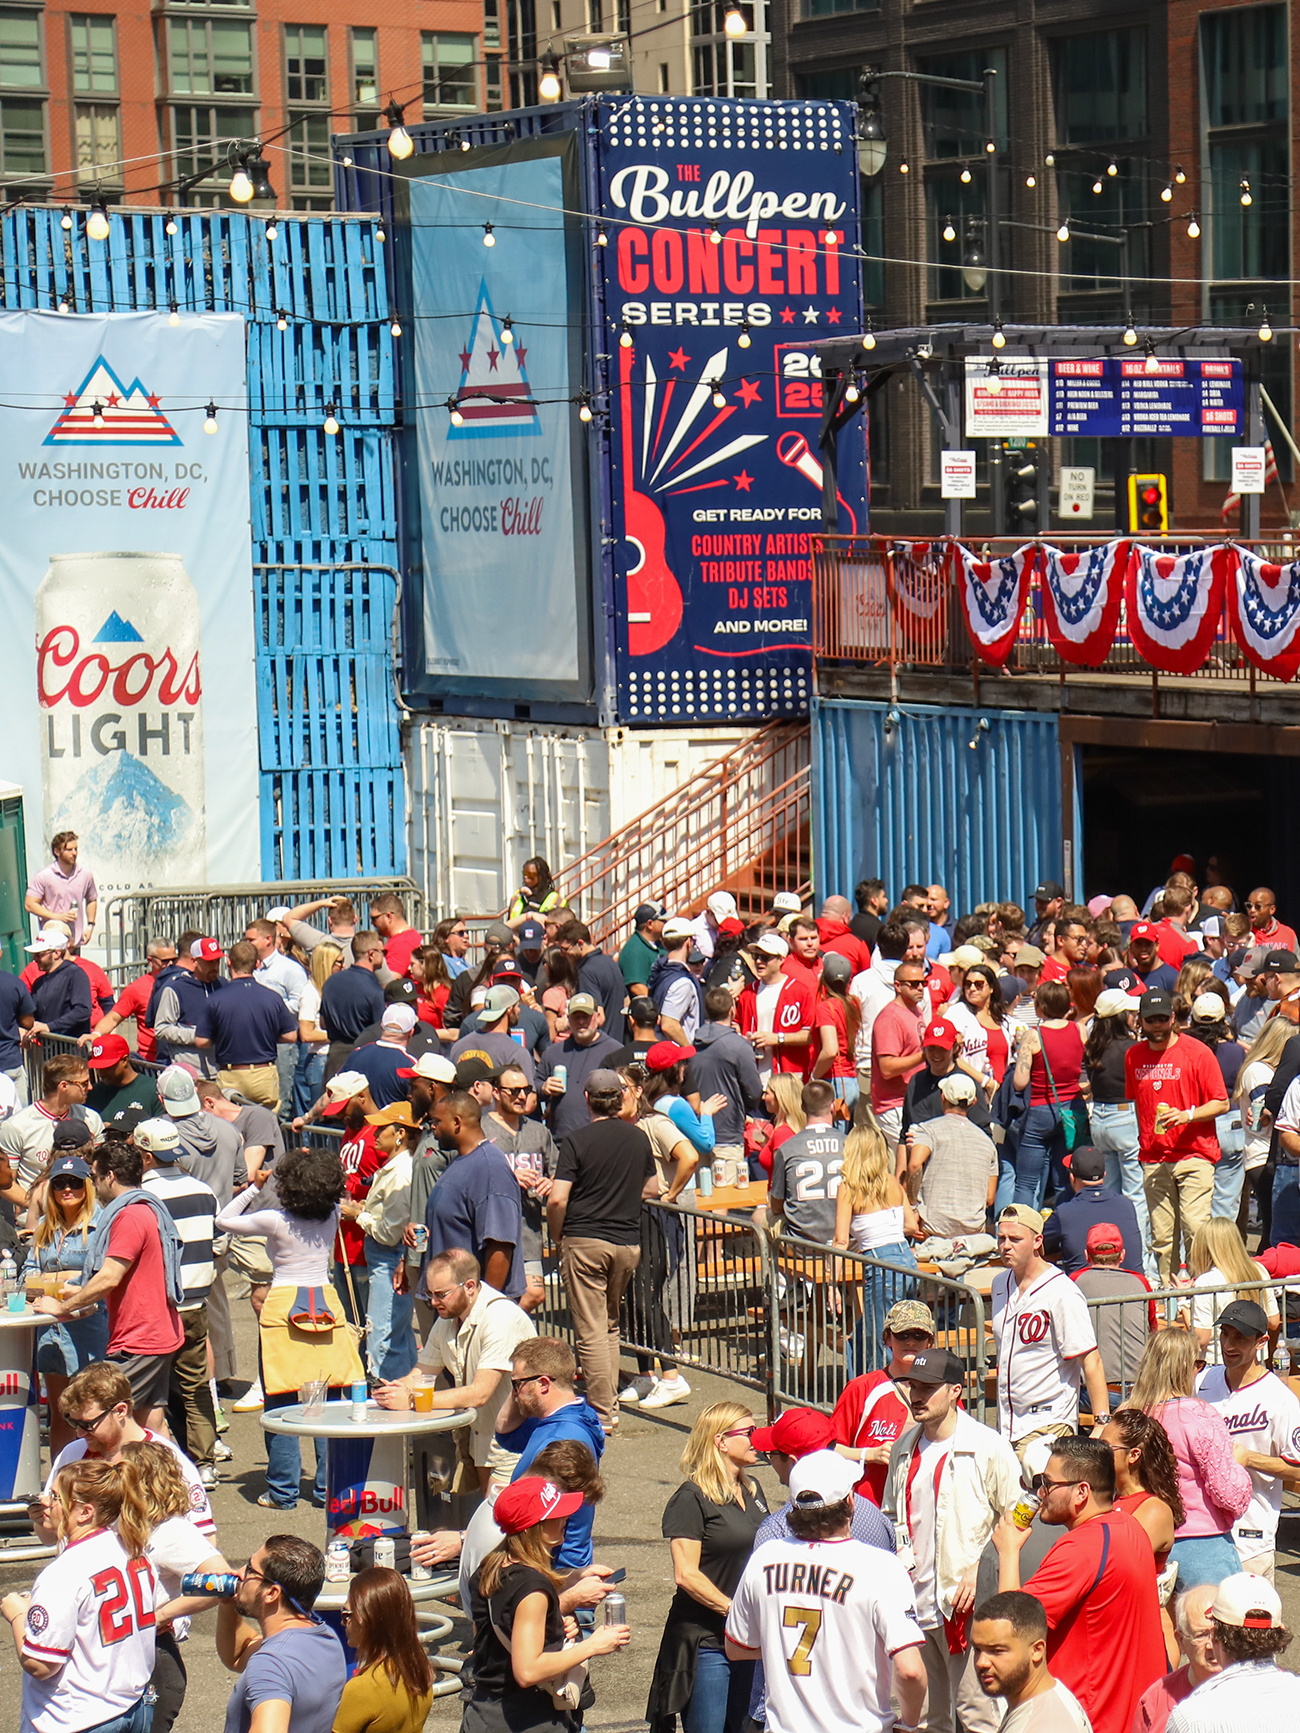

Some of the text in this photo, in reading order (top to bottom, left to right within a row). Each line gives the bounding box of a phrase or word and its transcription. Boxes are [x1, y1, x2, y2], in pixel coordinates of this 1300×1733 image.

[676, 164, 701, 181] THE
[609, 164, 847, 239] Bullpen
[617, 227, 845, 295] CONCERT
[621, 302, 773, 326] SERIES
[1058, 363, 1100, 373] BEER & WINE
[1145, 364, 1181, 374] KTAILS
[1215, 411, 1233, 421] SHOTS
[18, 463, 208, 483] WASHINGTON, DC,
[432, 457, 553, 491] WASHINGTON, DC,
[1071, 472, 1084, 480] NO
[33, 487, 190, 509] CHOOSE Chill
[1064, 493, 1090, 501] ON RED
[1068, 483, 1087, 491] TURN
[440, 496, 544, 536] CHOOSE Chill
[692, 508, 822, 522] GET READY FOR
[691, 534, 762, 556] COUNTRY
[700, 561, 762, 582] TRIBUTE
[728, 587, 788, 609] DJ SETS
[713, 619, 808, 634] AND MORE!
[35, 625, 202, 708] Coors
[47, 712, 195, 758] LIGHT
[99, 883, 131, 891] COLD
[780, 1002, 801, 1028] W
[1135, 1068, 1181, 1080] NATIONALS
[807, 1138, 839, 1154] SOTO
[1018, 1308, 1049, 1344] W
[360, 1486, 403, 1514] Bull
[763, 1562, 855, 1606] TURNER
[89, 1555, 156, 1648] 20
[783, 1605, 822, 1677] 7
